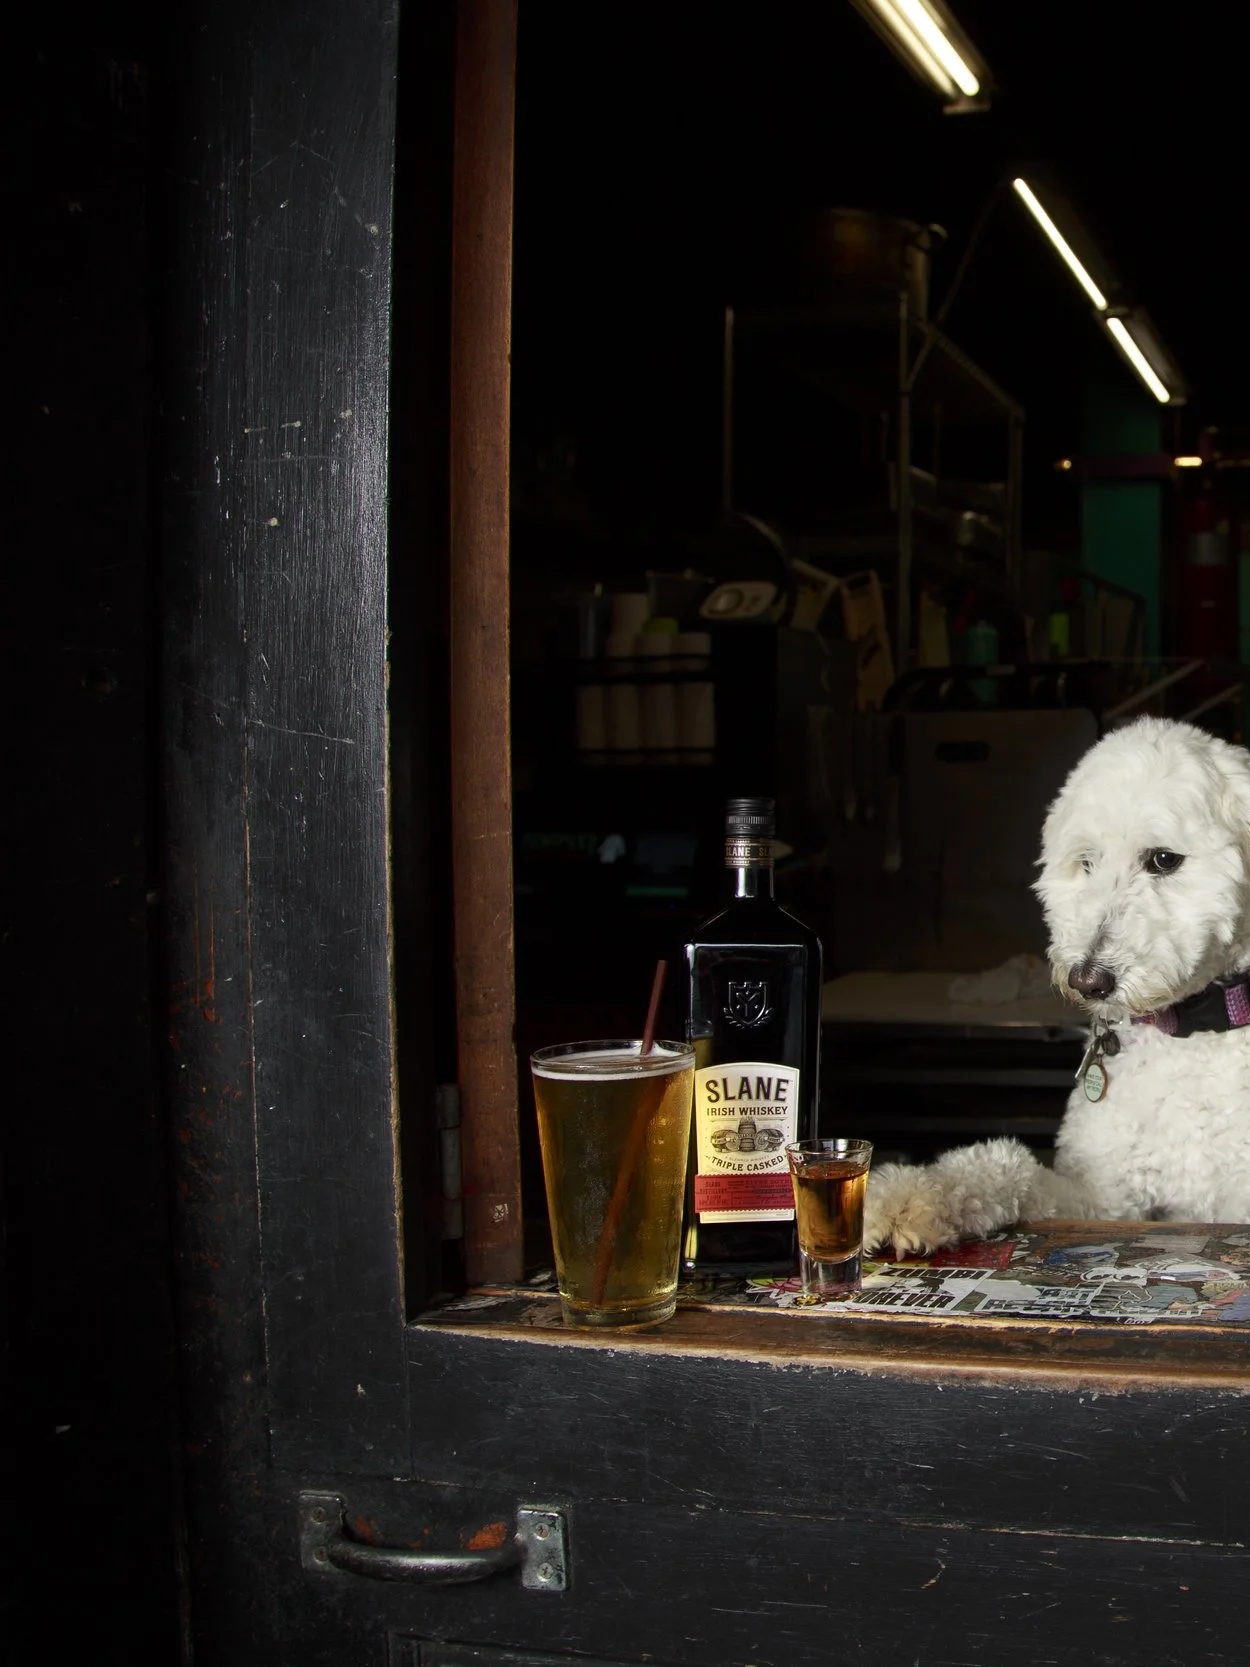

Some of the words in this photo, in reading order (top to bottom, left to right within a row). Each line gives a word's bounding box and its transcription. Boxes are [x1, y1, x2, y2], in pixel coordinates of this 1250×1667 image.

[705, 1076, 789, 1103] SLANE
[706, 1107, 735, 1117] IRISH
[738, 1106, 788, 1117] WHISKEY
[711, 1156, 743, 1171] TRIPLE
[746, 1155, 784, 1172] CASKED
[879, 1267, 989, 1280] ZUMBI
